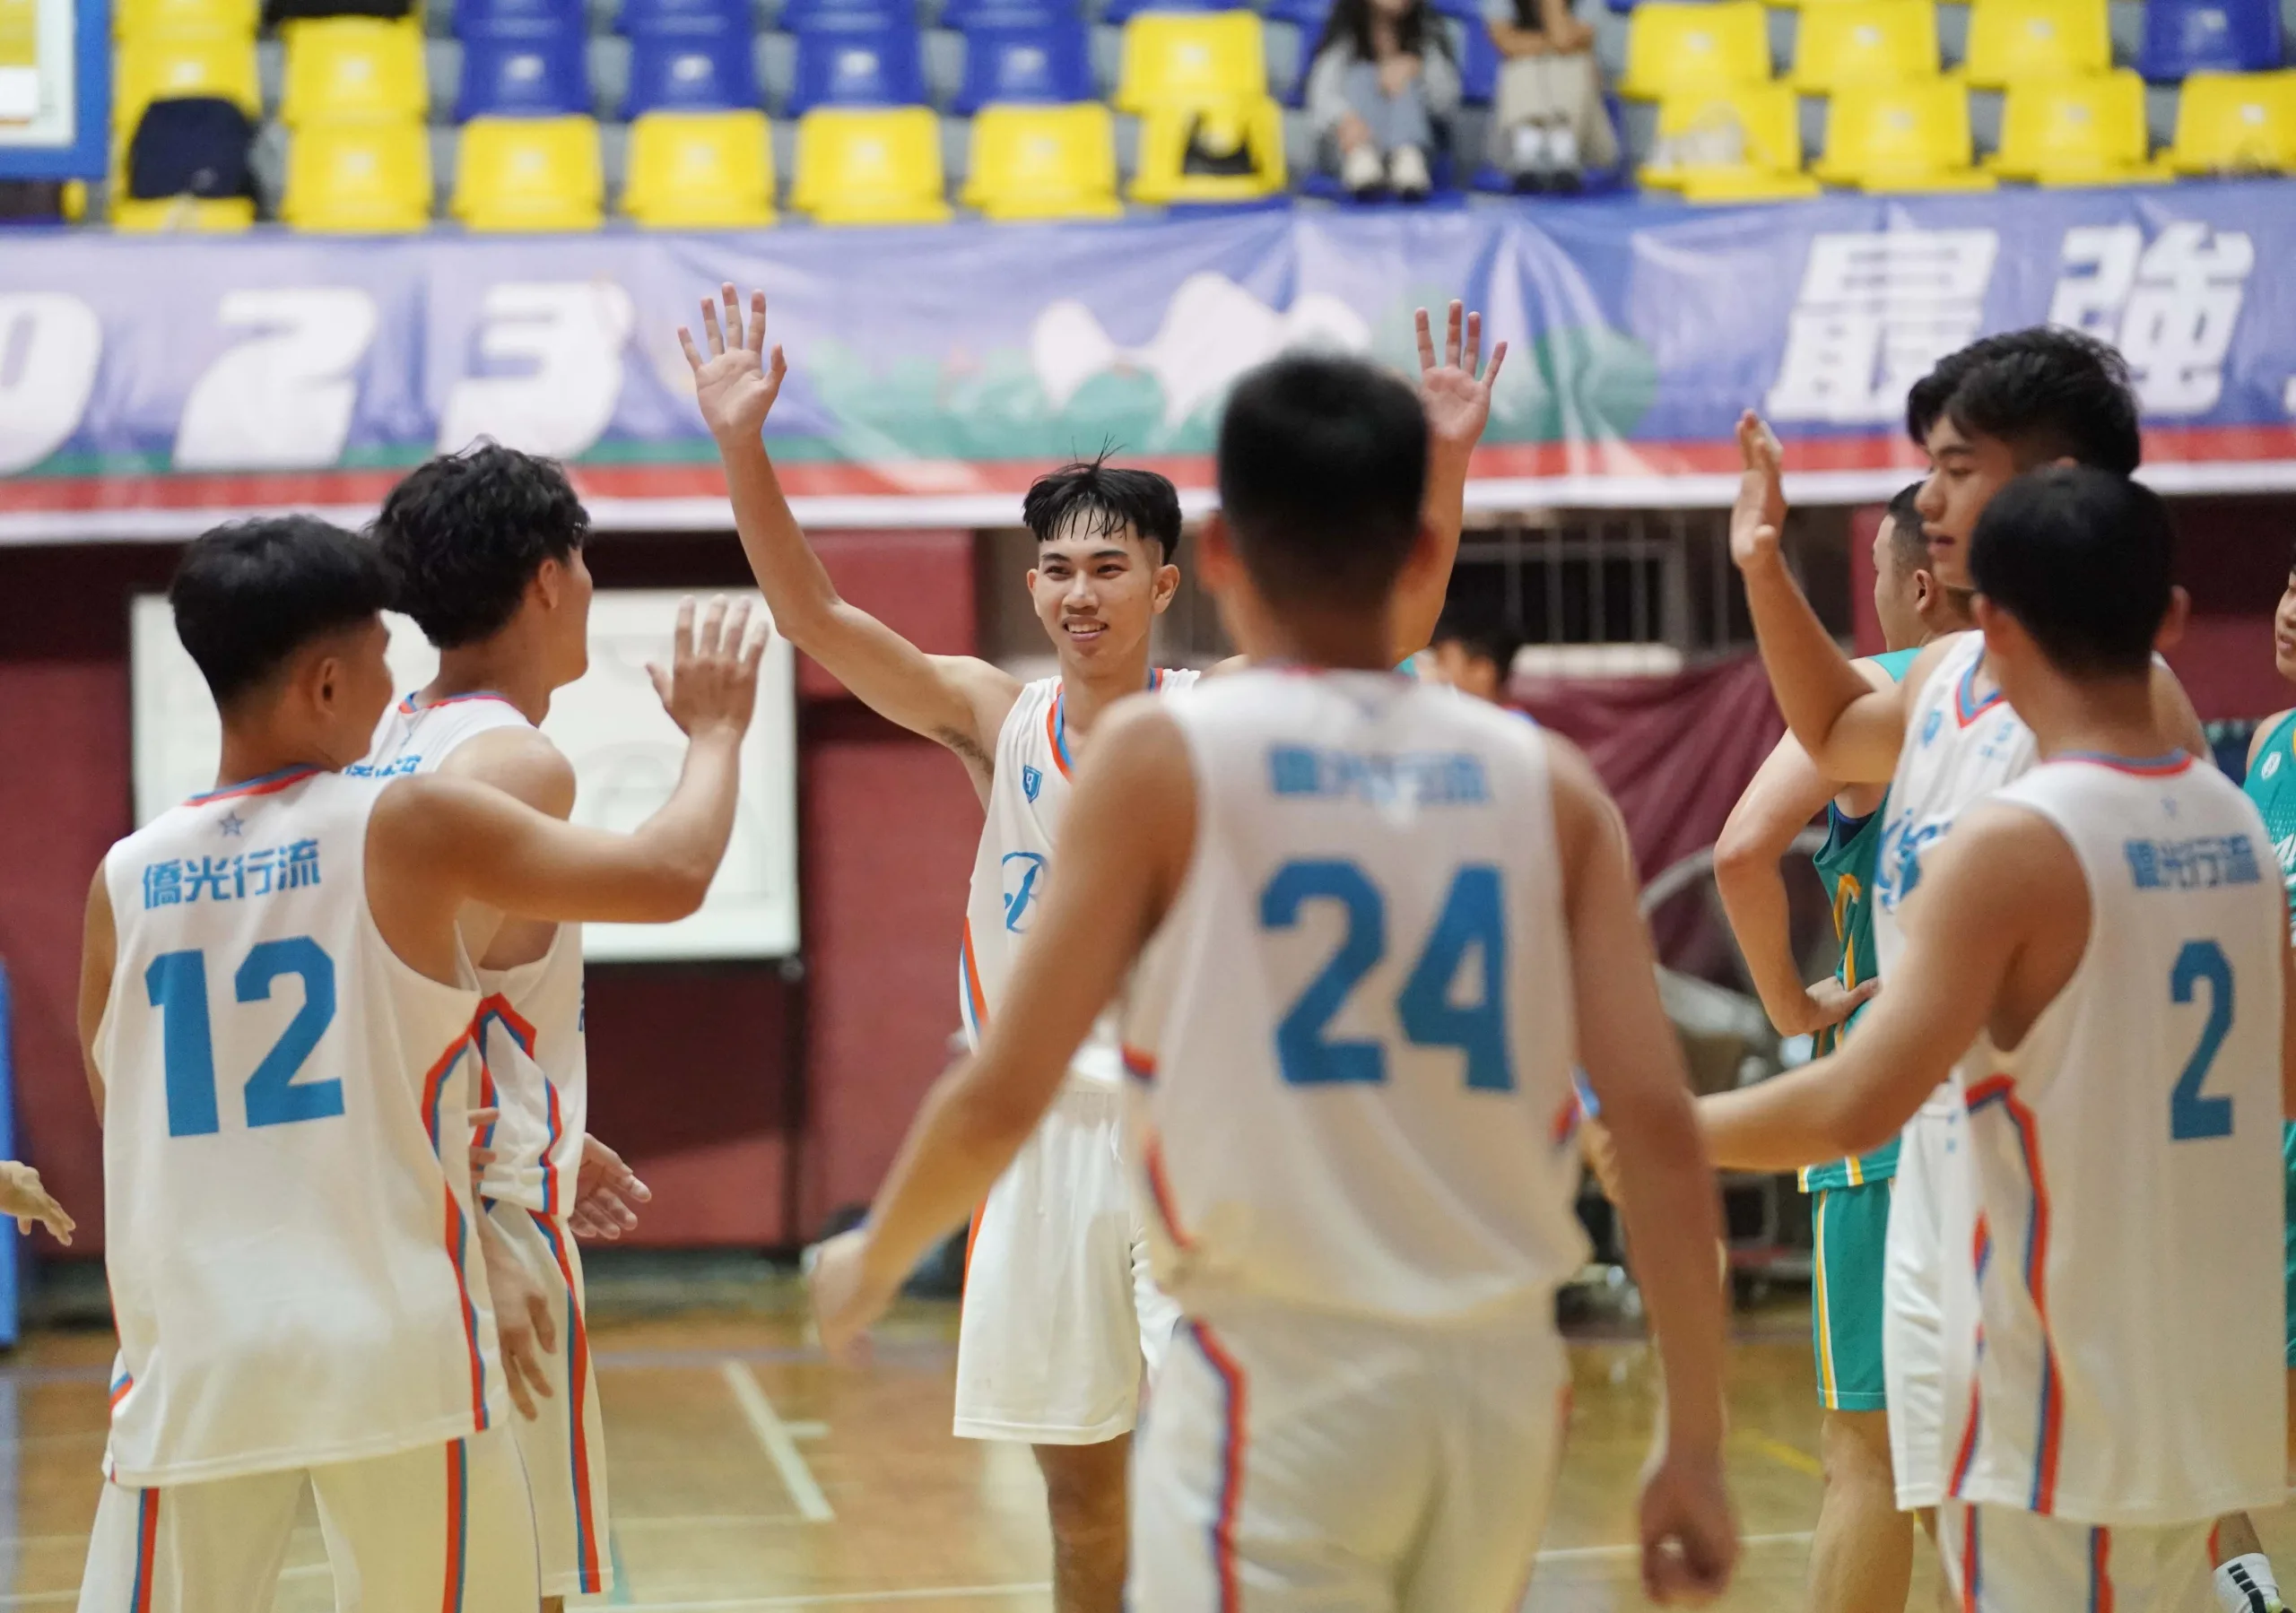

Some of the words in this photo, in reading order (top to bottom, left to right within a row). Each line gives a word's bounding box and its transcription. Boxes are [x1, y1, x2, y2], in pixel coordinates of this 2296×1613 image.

[1765, 221, 2296, 425] 最強
[142, 838, 321, 910] 僑光行流
[1259, 857, 1517, 1092] 24
[144, 935, 345, 1138] 12
[2169, 939, 2235, 1141] 2
